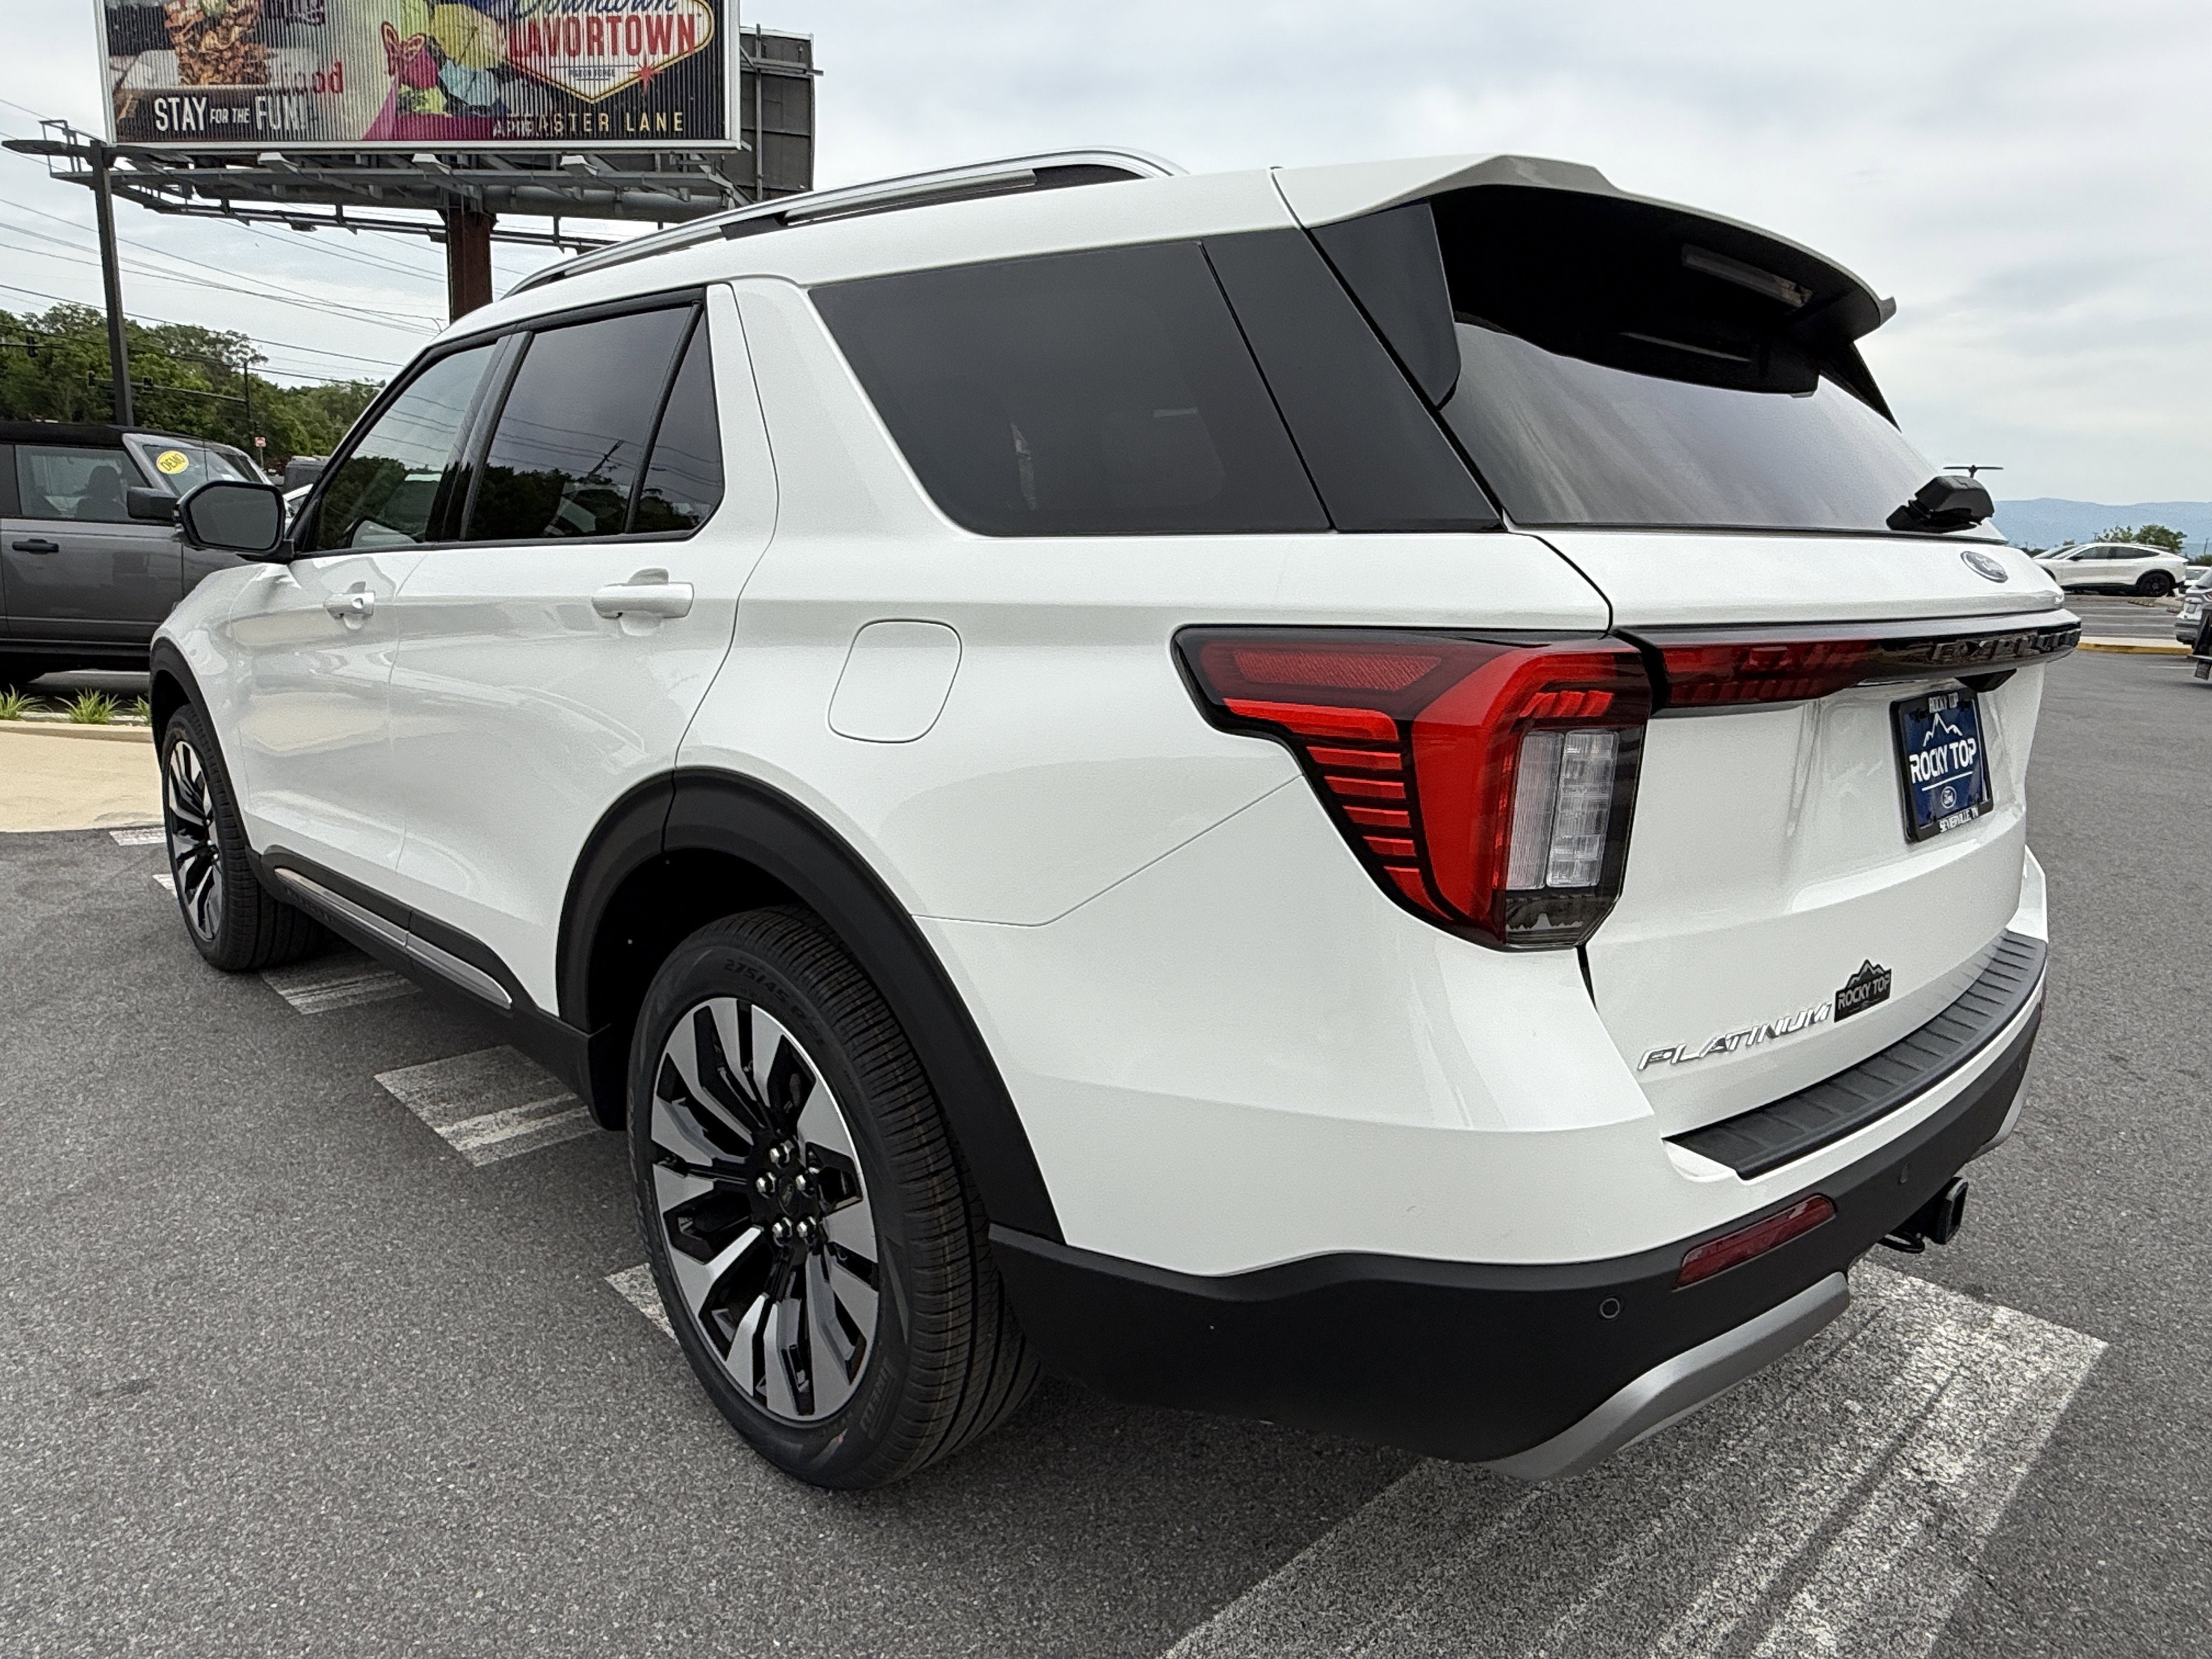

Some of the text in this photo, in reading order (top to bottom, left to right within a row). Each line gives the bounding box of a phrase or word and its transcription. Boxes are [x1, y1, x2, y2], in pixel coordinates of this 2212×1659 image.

[154, 97, 207, 131] STAY
[210, 109, 229, 124] FOR
[232, 108, 250, 124] THE
[626, 112, 684, 131] LANE
[161, 454, 186, 471] DEMO
[1909, 738, 1977, 785] ROCKY TOP
[1838, 973, 1891, 1011] ROCKY TOP
[1637, 1002, 1832, 1070] PLATINUM
